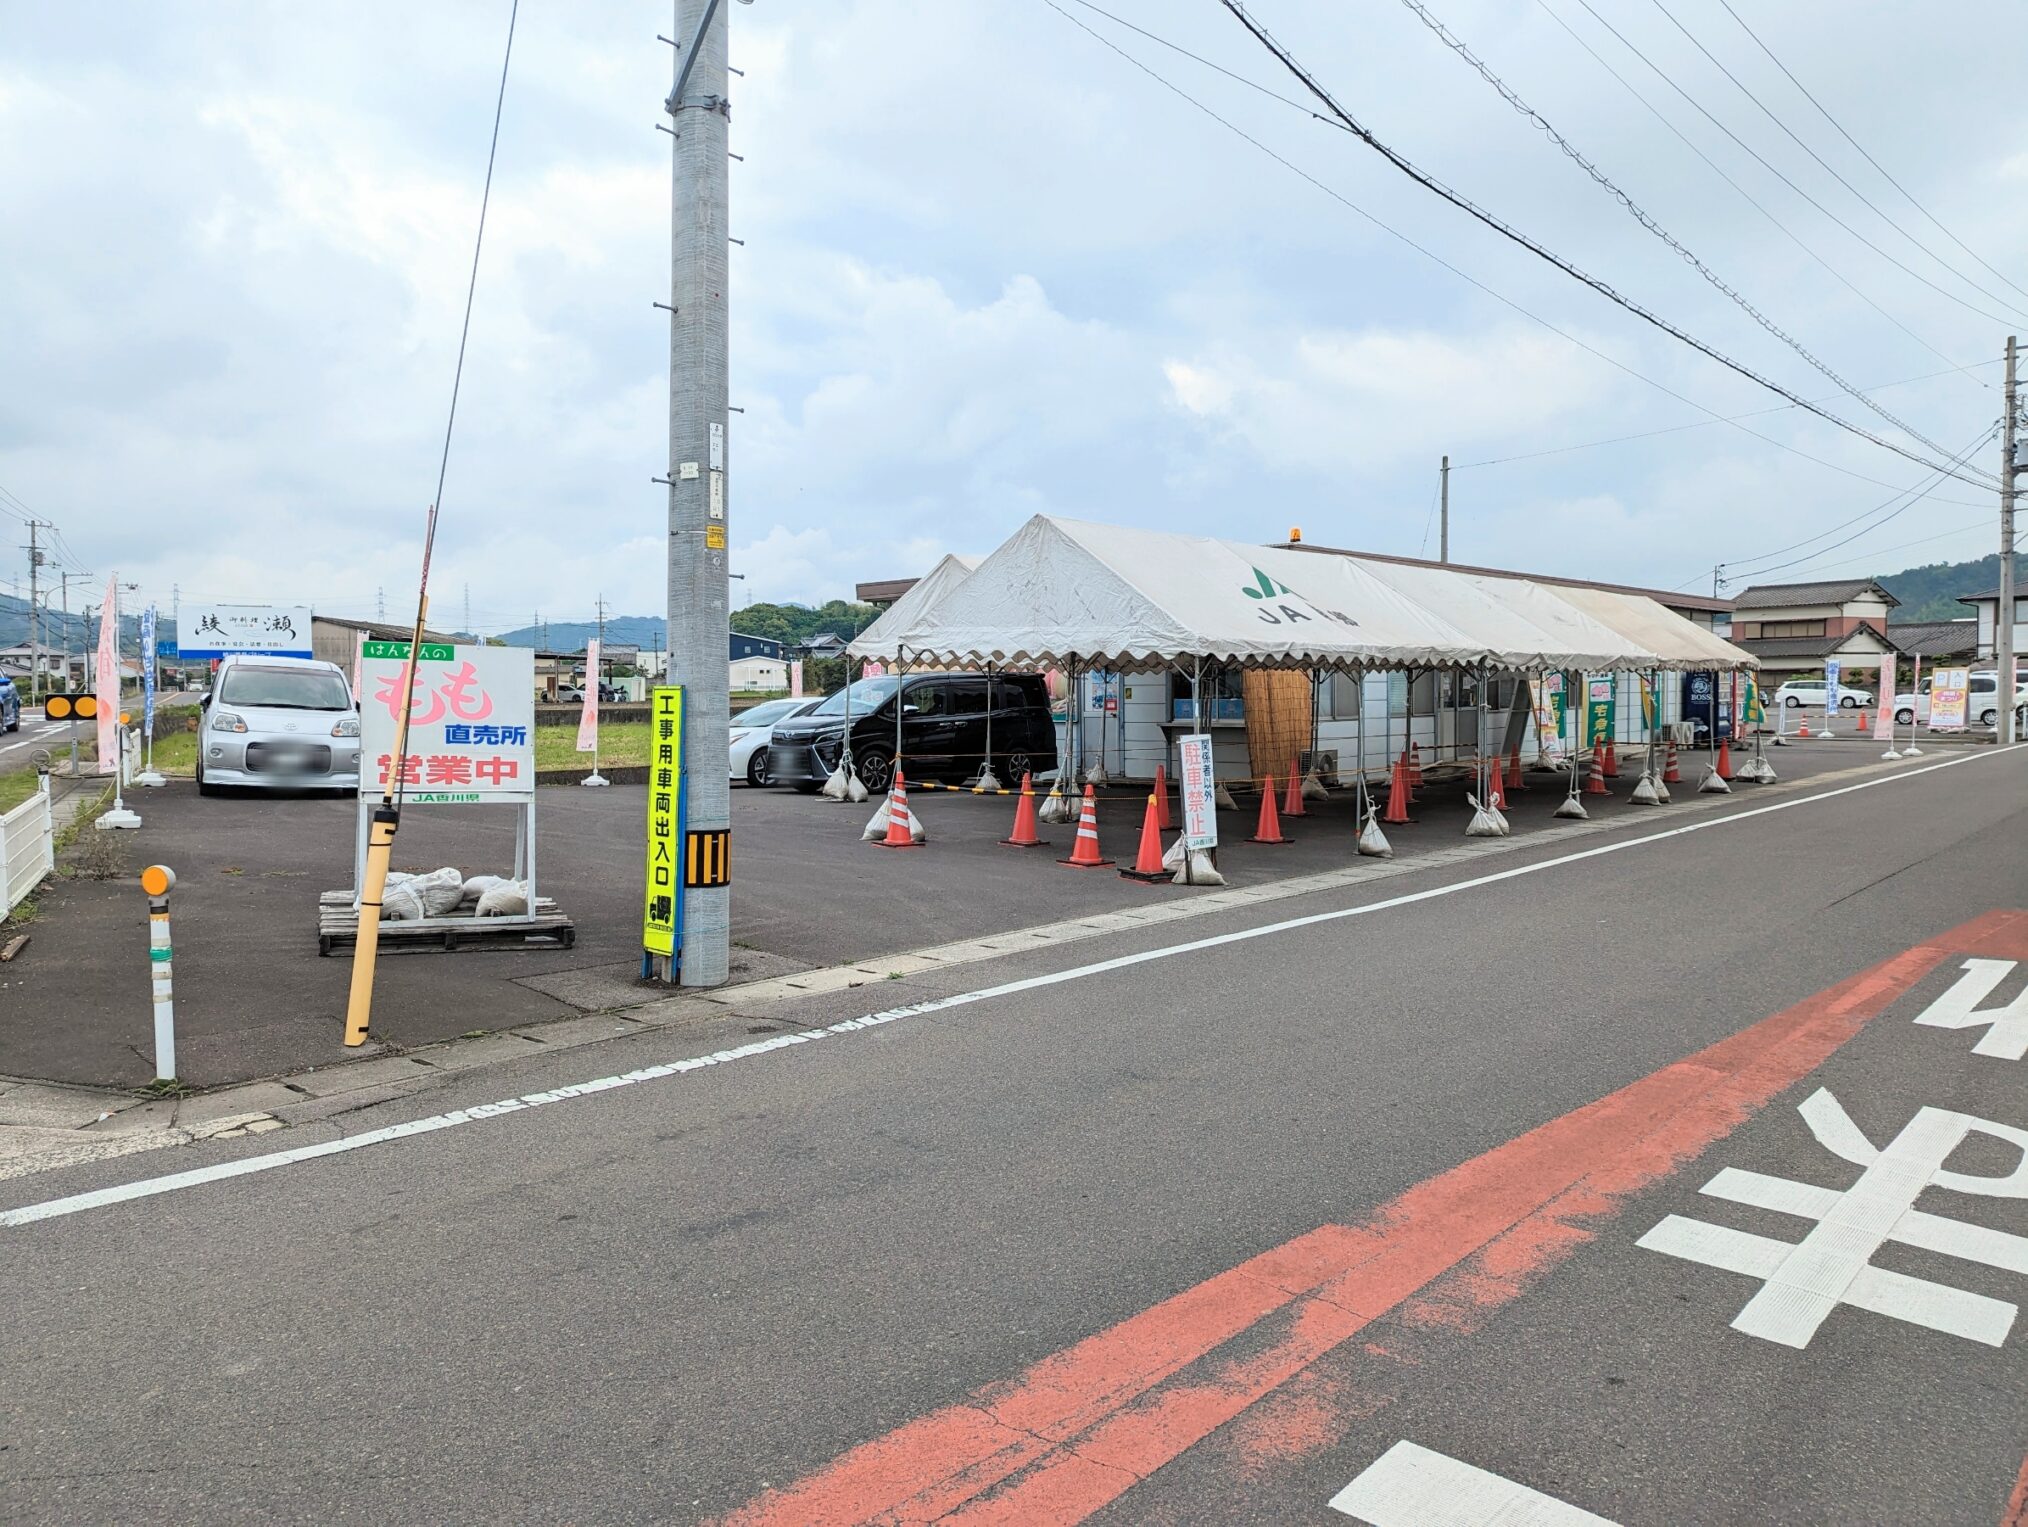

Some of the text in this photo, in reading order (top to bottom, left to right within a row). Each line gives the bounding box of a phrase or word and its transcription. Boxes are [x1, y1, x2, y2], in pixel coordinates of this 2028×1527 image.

[1257, 604, 1312, 624] JA
[374, 661, 494, 726] もも
[445, 724, 527, 746] 直売所
[377, 754, 518, 785] 営業中
[654, 694, 675, 886] 工事用車両出入口
[1185, 743, 1206, 836] 駐車禁止
[1202, 739, 1212, 802] 関係者以外
